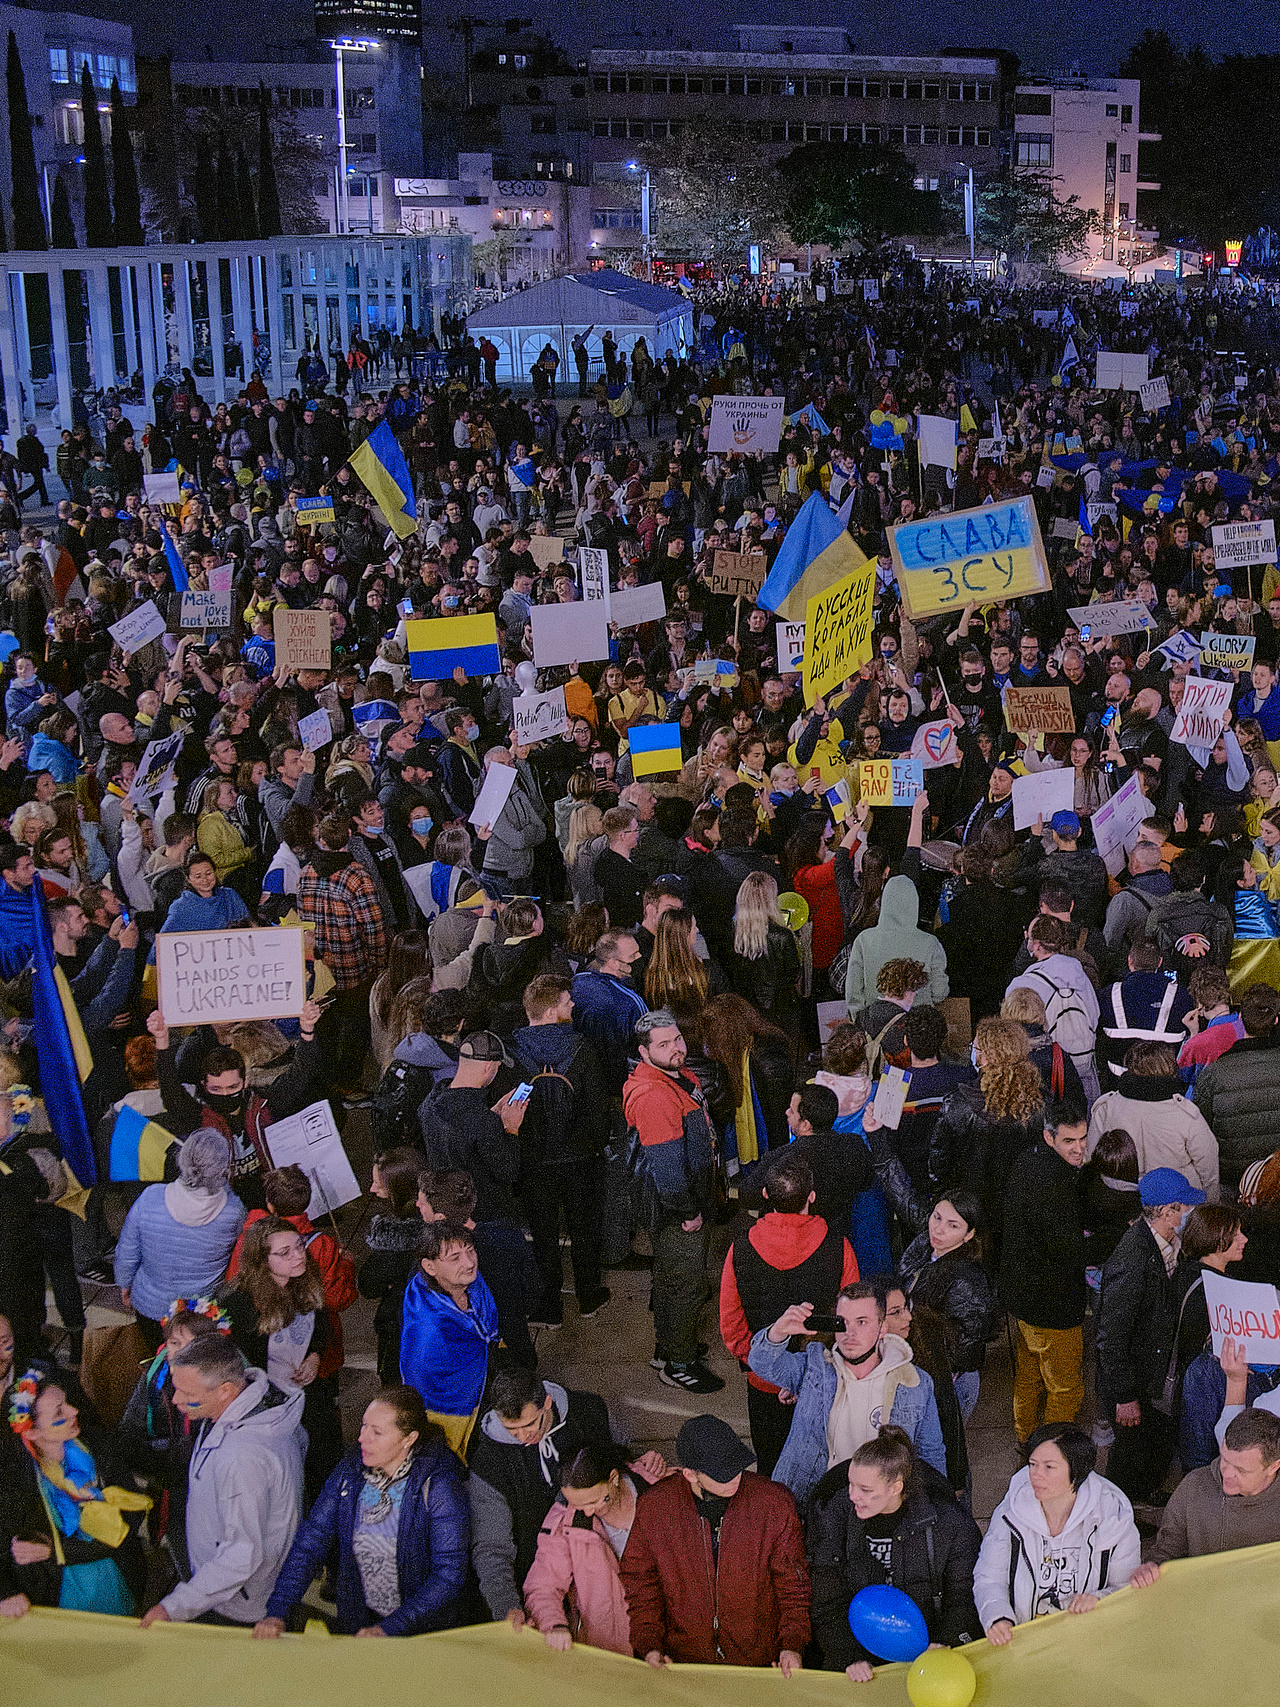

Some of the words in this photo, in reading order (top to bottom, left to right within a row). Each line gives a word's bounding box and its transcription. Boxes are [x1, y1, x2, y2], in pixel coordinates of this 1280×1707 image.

[714, 400, 736, 409] РУКИ
[739, 402, 769, 410] ПРОЧЬ
[772, 402, 783, 410] ОТ
[725, 411, 767, 419] УКРАИНЫ
[915, 508, 1026, 563] СЛАВА
[718, 553, 761, 571] STOP
[712, 575, 762, 595] PUTIN
[932, 554, 1013, 602] ЗСУ
[184, 593, 216, 606] Make
[205, 605, 229, 617] love
[182, 615, 203, 627] not
[207, 616, 229, 626] WAR
[1209, 638, 1248, 655] GLORY
[1185, 682, 1228, 708] ПУТІН
[174, 935, 256, 967] PUTIN
[175, 965, 240, 988] HANDS
[245, 961, 285, 980] OFF
[177, 980, 293, 1014] UKRAINE!
